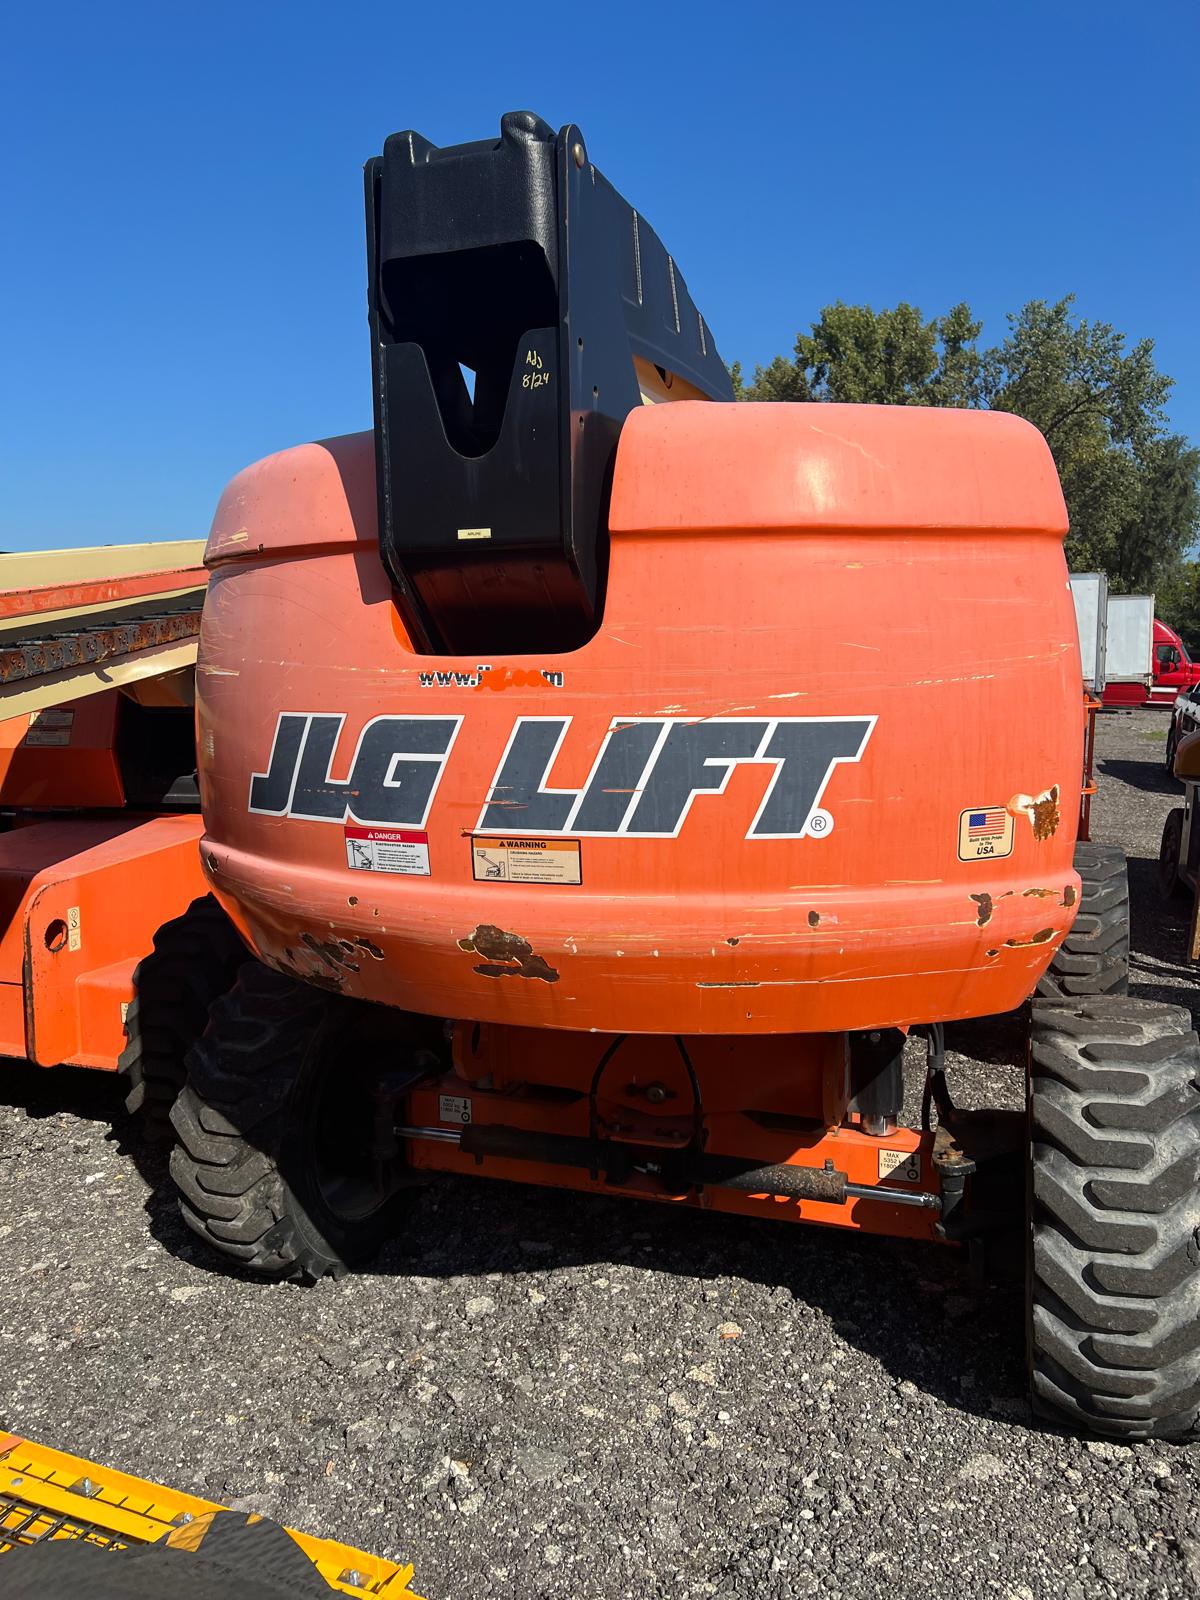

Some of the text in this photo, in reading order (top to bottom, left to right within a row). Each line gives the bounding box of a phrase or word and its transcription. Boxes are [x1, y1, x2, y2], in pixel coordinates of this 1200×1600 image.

[522, 371, 550, 390] 8/24
[248, 712, 465, 830] JLG
[374, 832, 402, 841] DANGER
[506, 840, 547, 849] WARNING
[976, 845, 994, 855] USA
